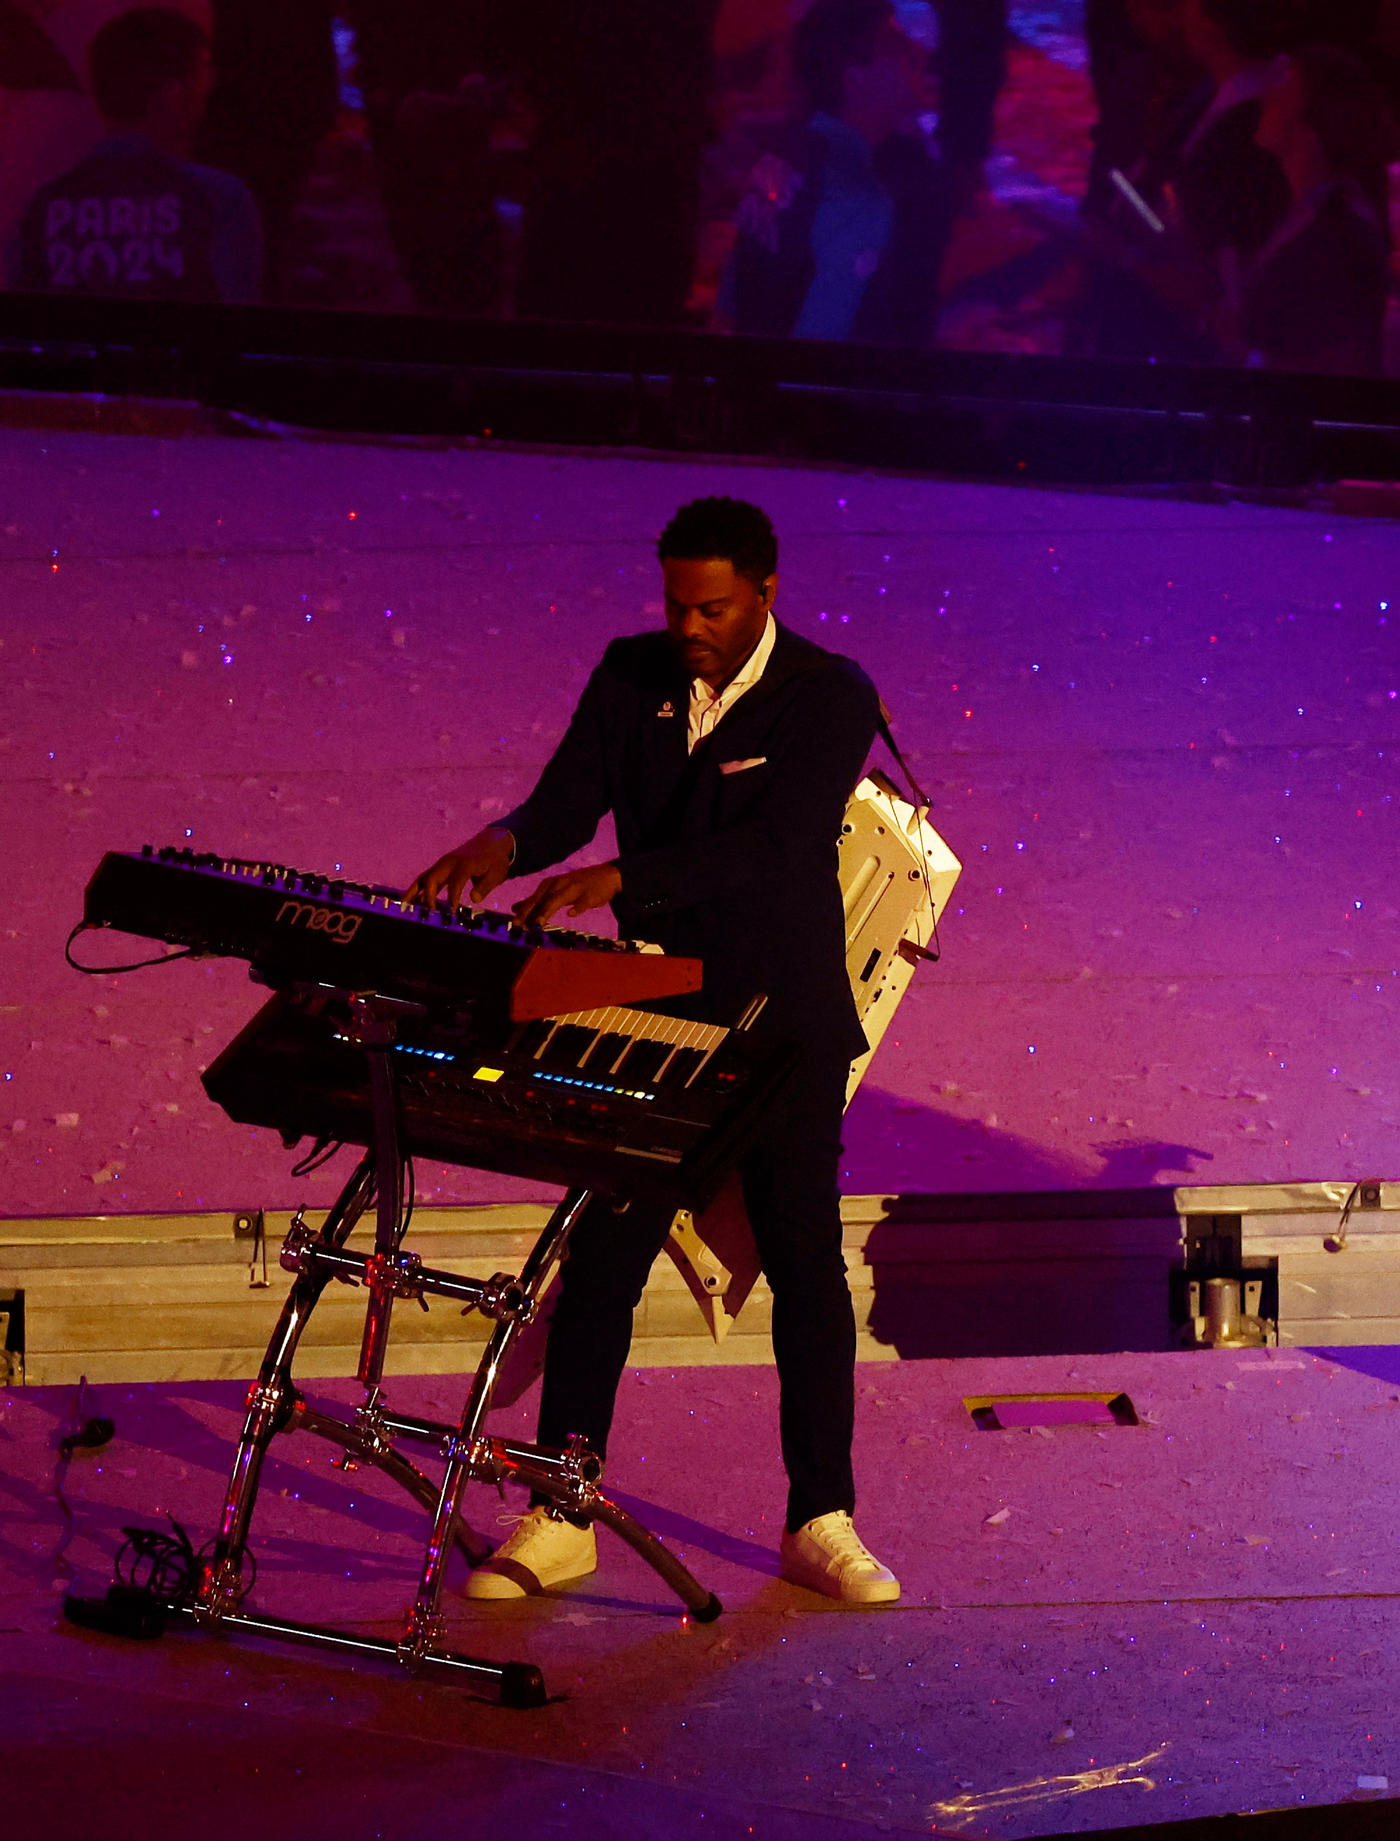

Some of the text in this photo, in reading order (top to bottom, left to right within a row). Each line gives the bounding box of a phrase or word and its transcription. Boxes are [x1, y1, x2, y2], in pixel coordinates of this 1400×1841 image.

[47, 197, 181, 236] PARIS
[47, 238, 184, 285] 2024
[274, 900, 364, 944] moog
